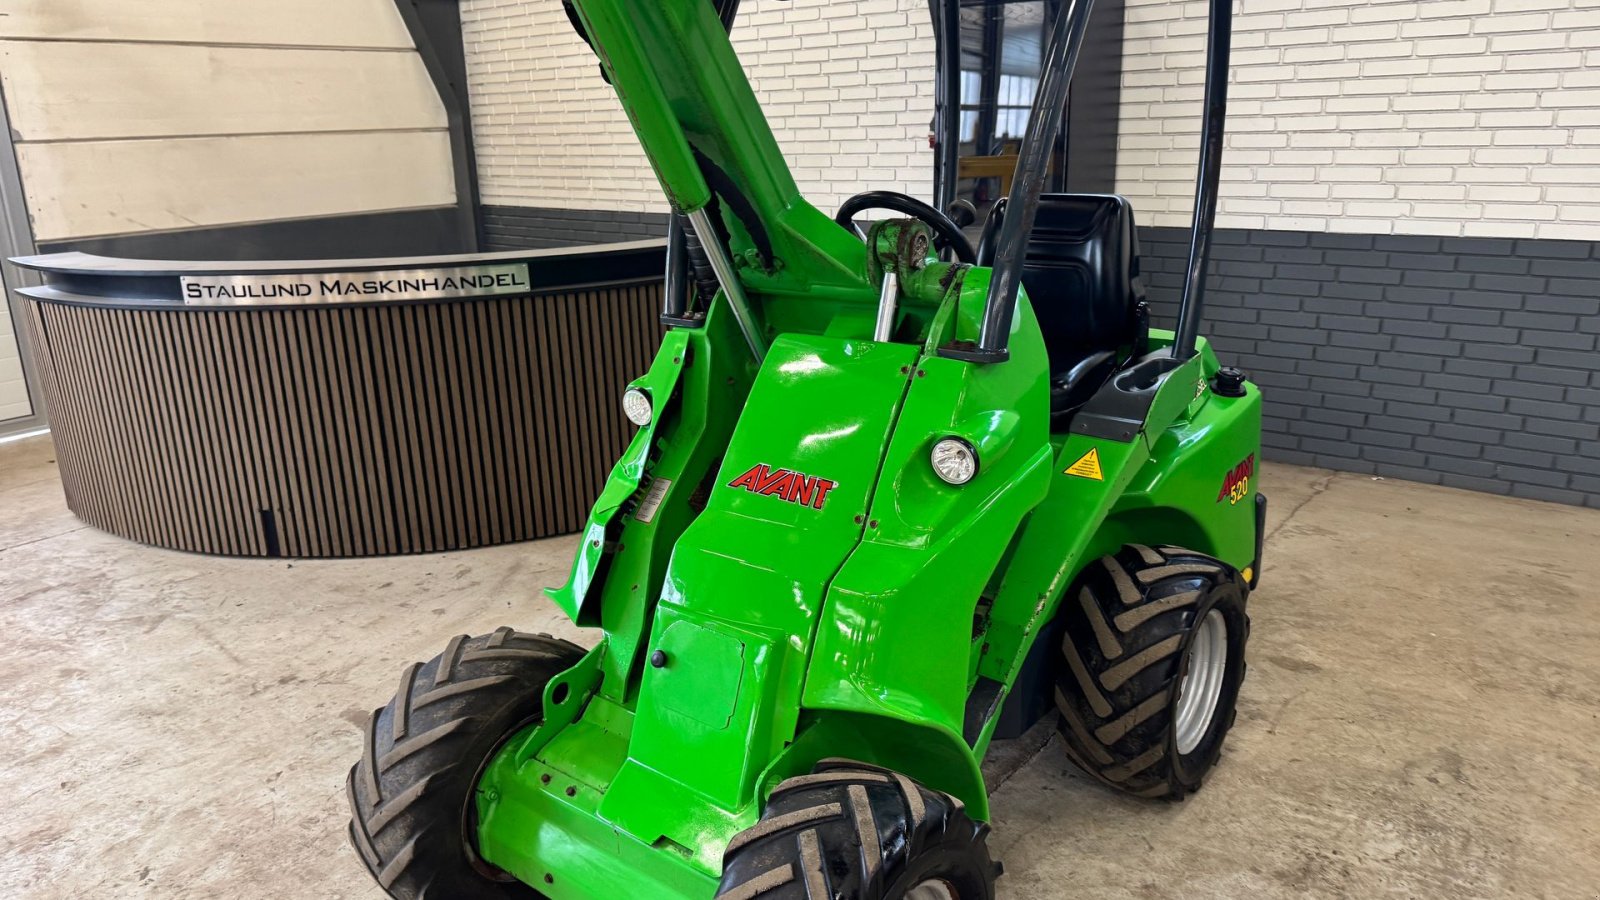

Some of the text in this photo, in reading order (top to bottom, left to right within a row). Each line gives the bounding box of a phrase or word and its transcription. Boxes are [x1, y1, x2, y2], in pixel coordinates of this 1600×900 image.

[186, 273, 526, 299] STAULUND MASKINHANDEL
[727, 463, 835, 510] AVANT
[1216, 452, 1254, 503] AVANT
[1230, 475, 1248, 505] 520
